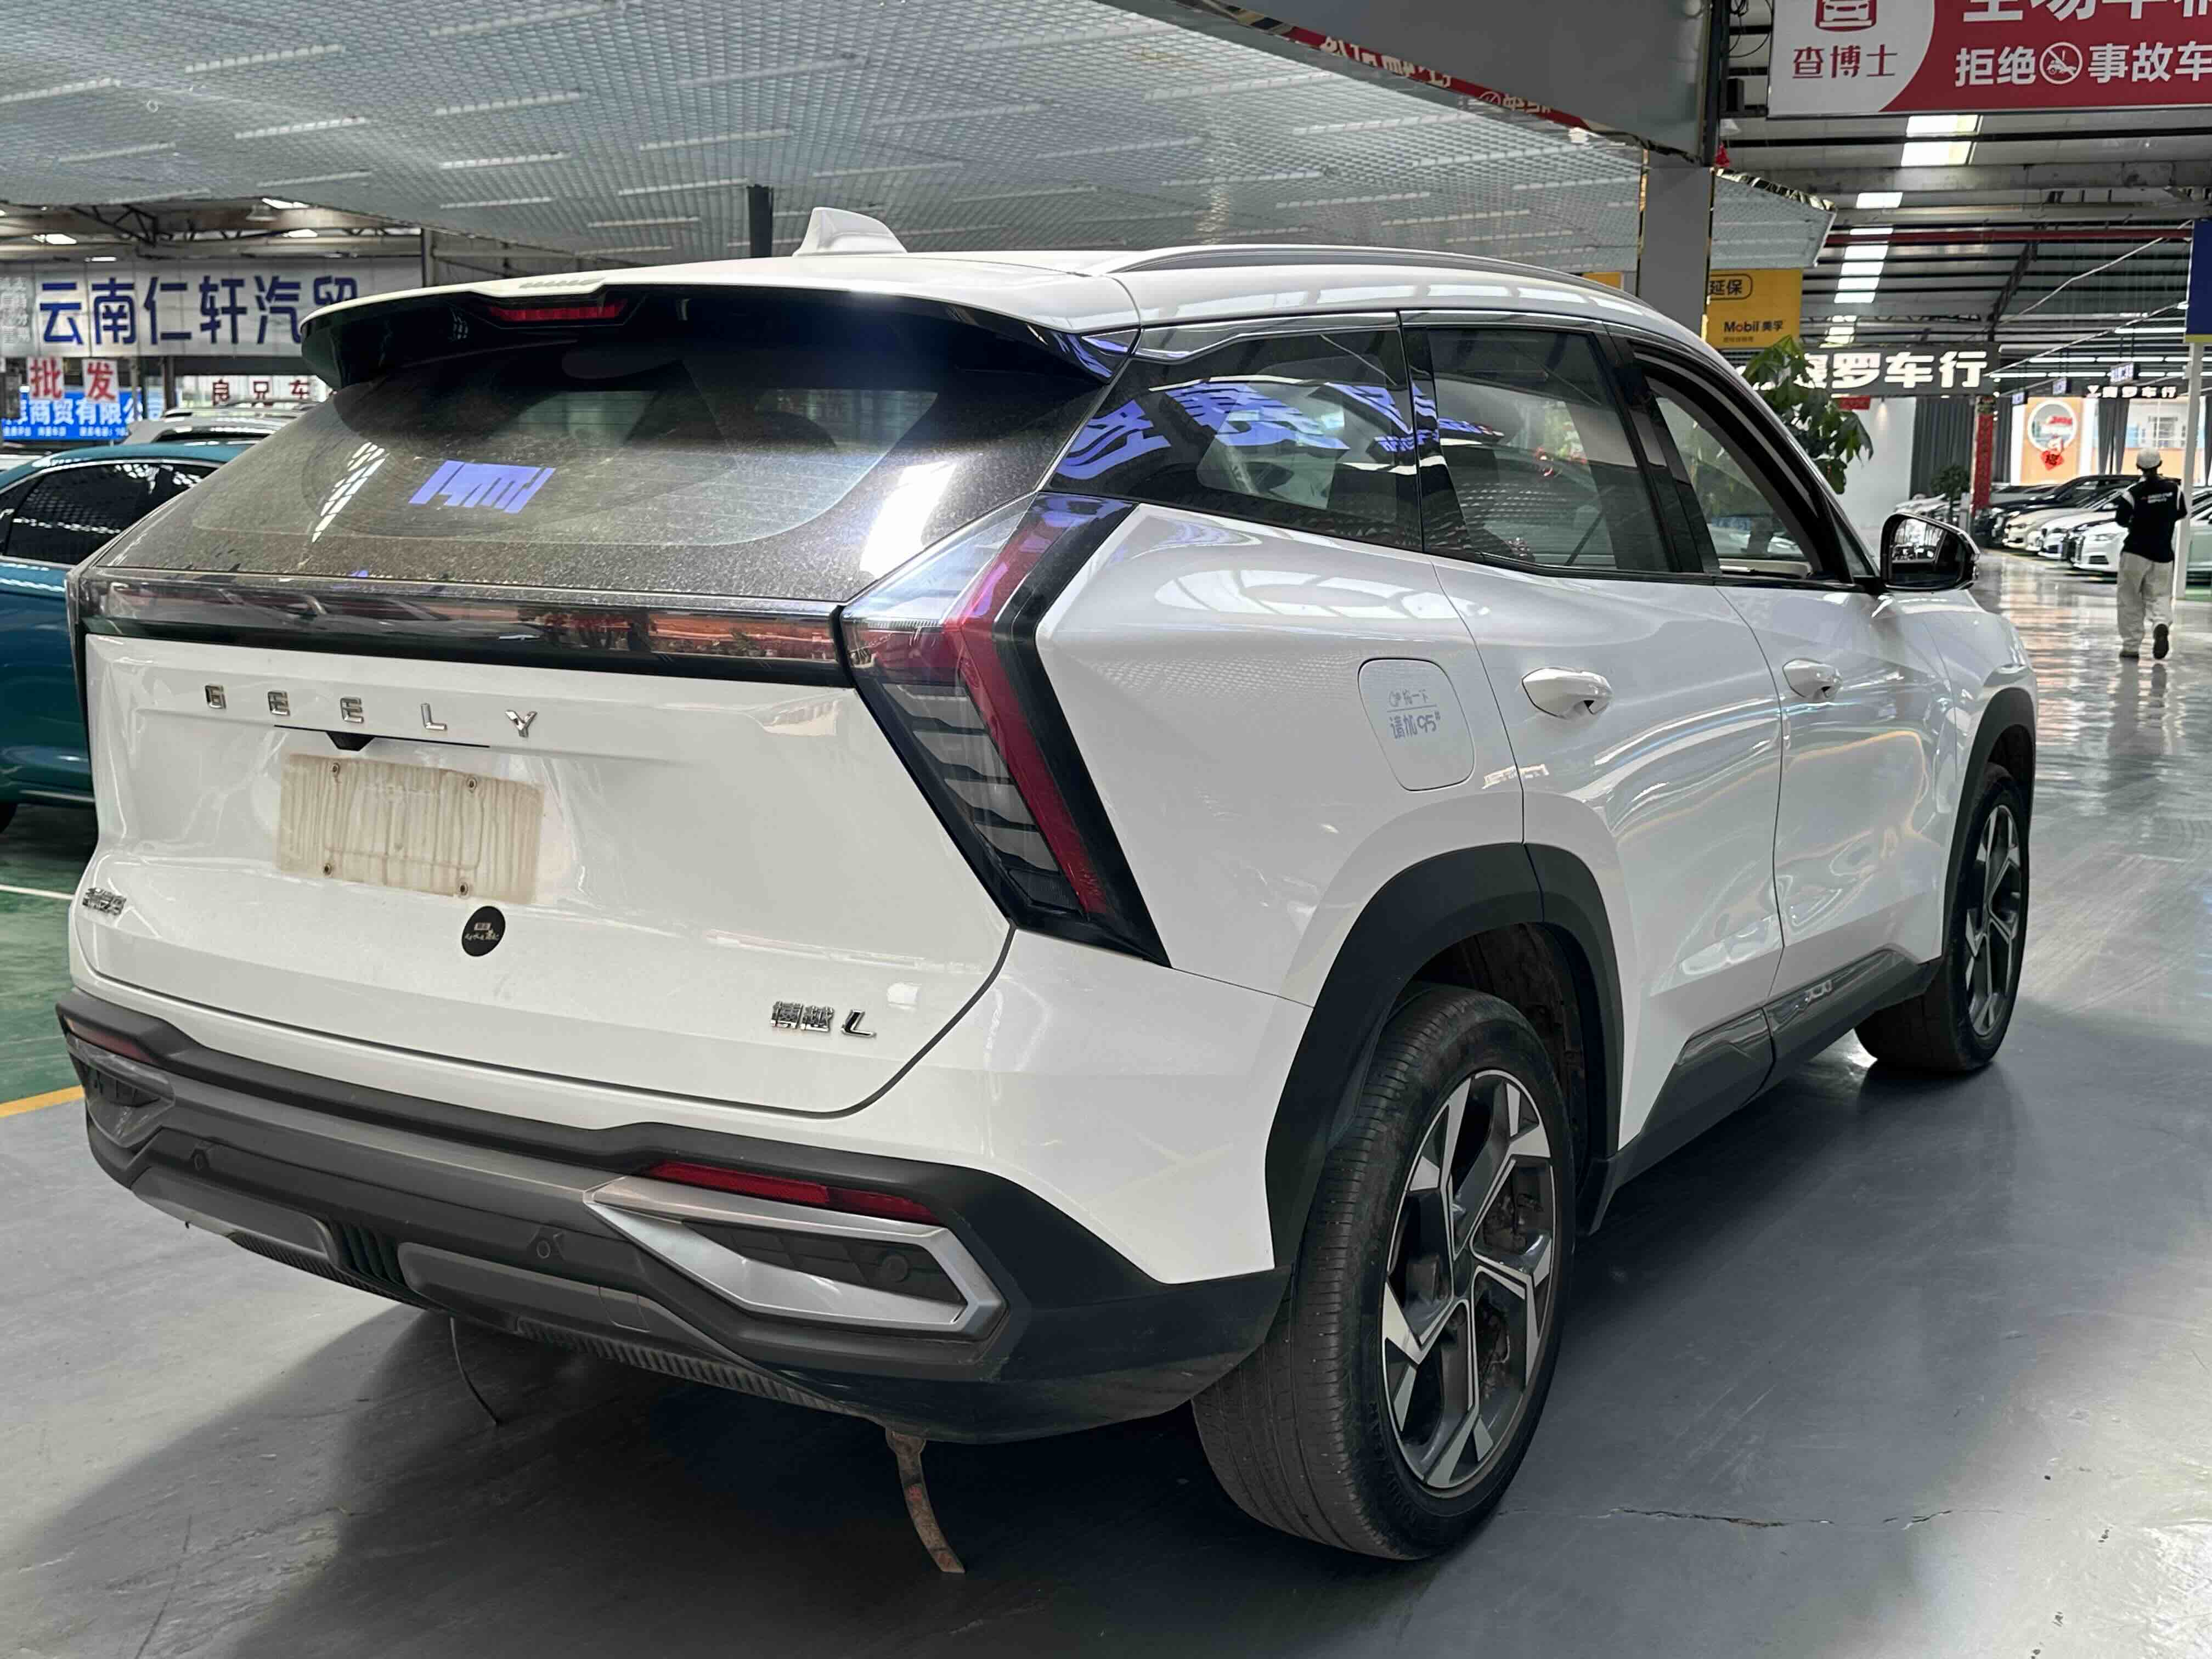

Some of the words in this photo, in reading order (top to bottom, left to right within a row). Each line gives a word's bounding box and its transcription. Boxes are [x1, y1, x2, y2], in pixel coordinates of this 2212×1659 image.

[1792, 44, 1898, 78] 查博士
[1955, 46, 2036, 87] 拒绝
[2087, 41, 2212, 83] 事故车
[1710, 279, 1742, 295] 延保
[1724, 321, 1759, 332] Mobil
[30, 359, 115, 401] 批发
[204, 684, 538, 738] GEELY
[839, 1009, 877, 1039] L
